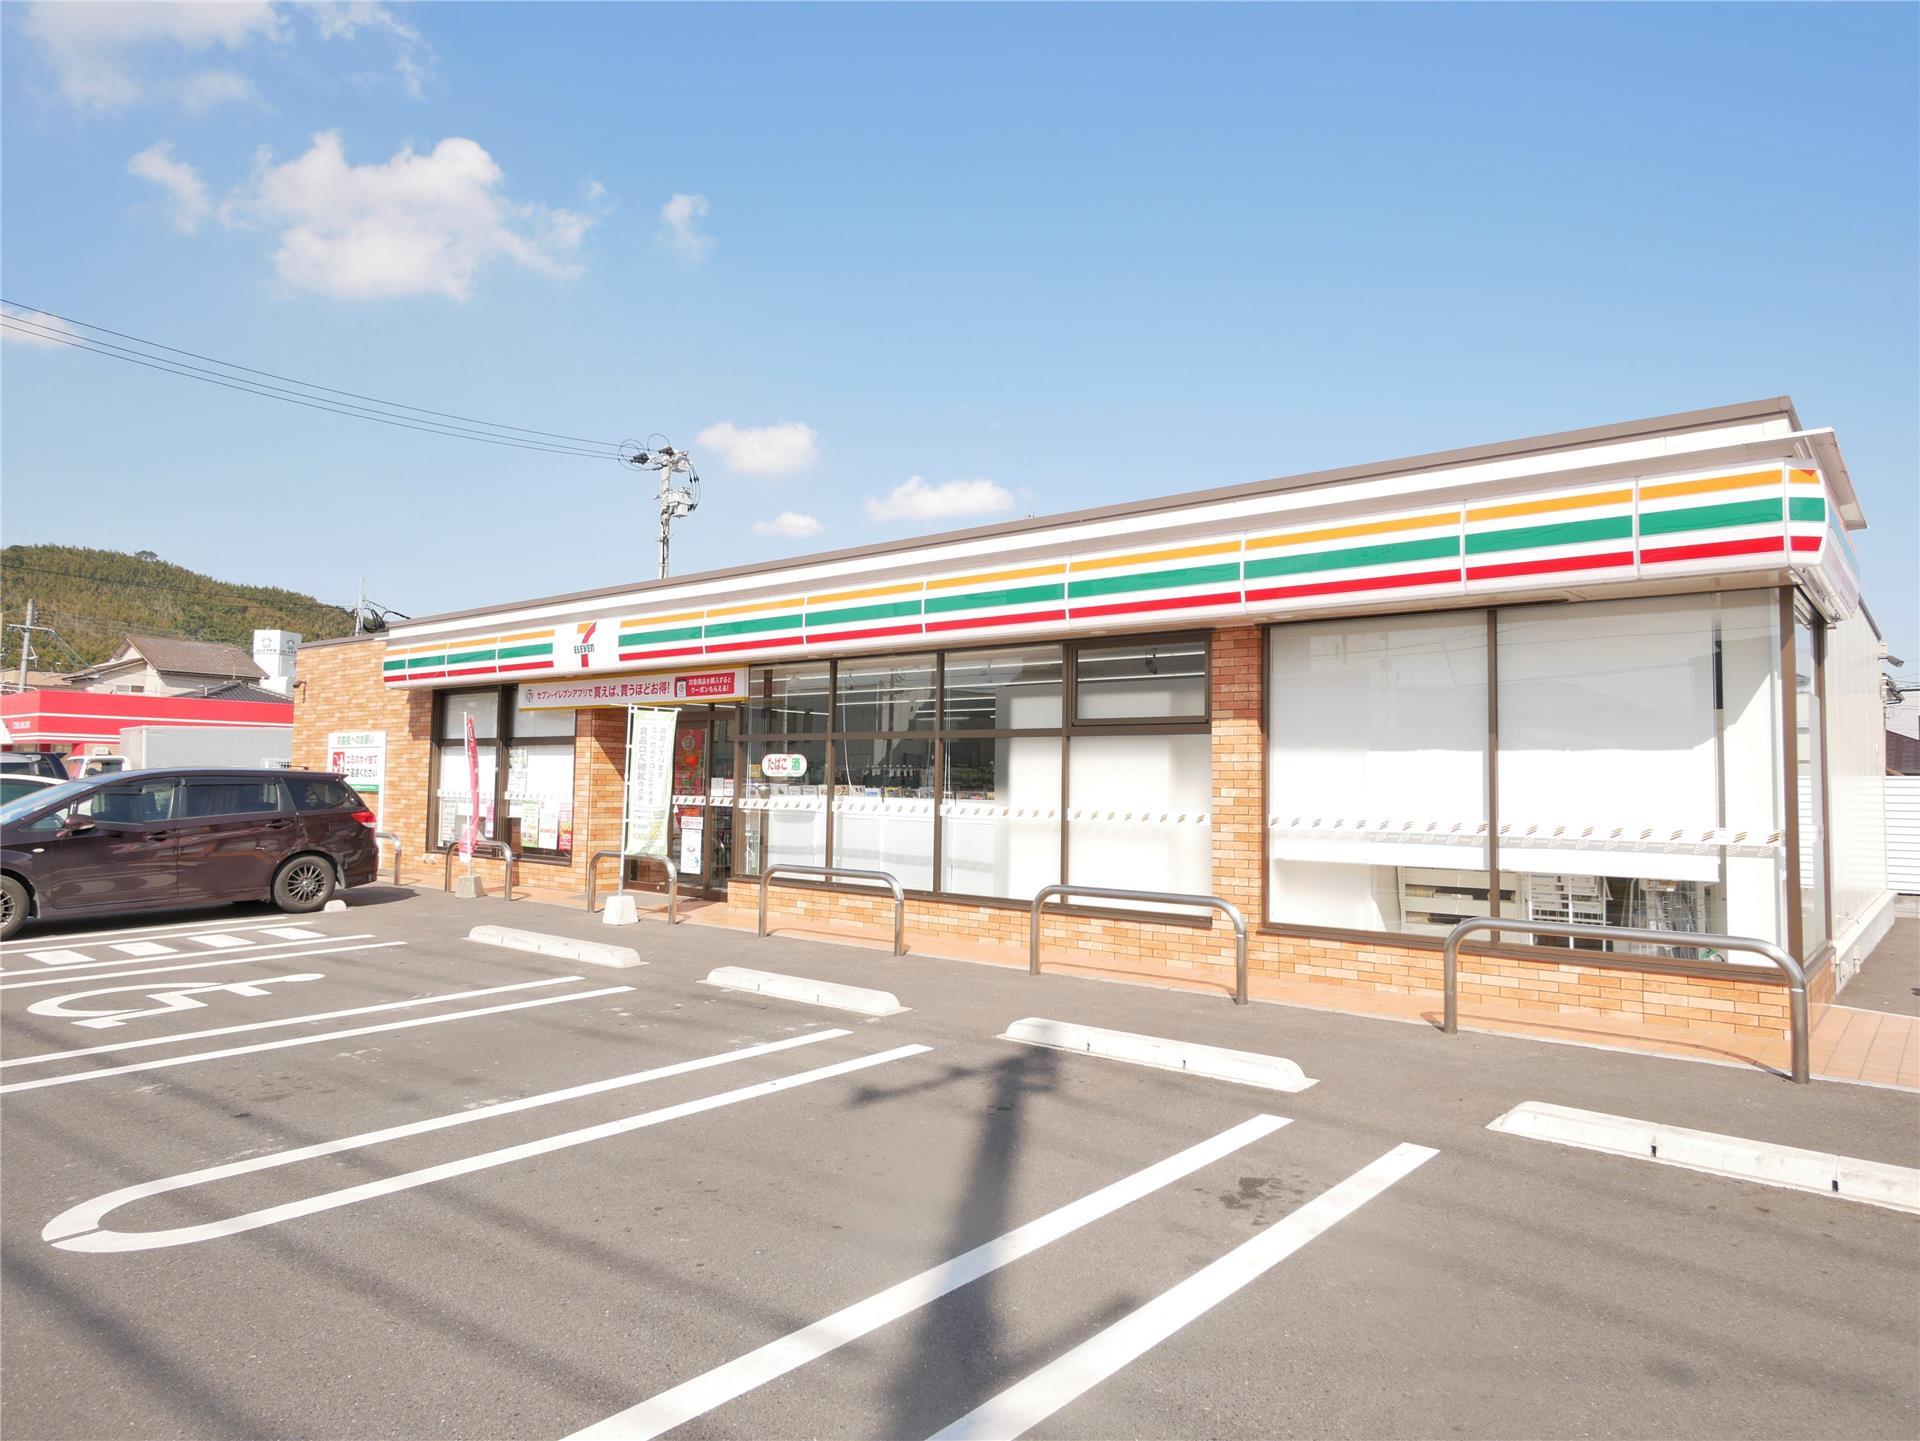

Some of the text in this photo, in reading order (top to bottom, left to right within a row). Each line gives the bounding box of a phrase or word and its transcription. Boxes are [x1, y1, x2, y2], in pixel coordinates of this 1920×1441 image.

[767, 757, 801, 771] たばこ 酒
